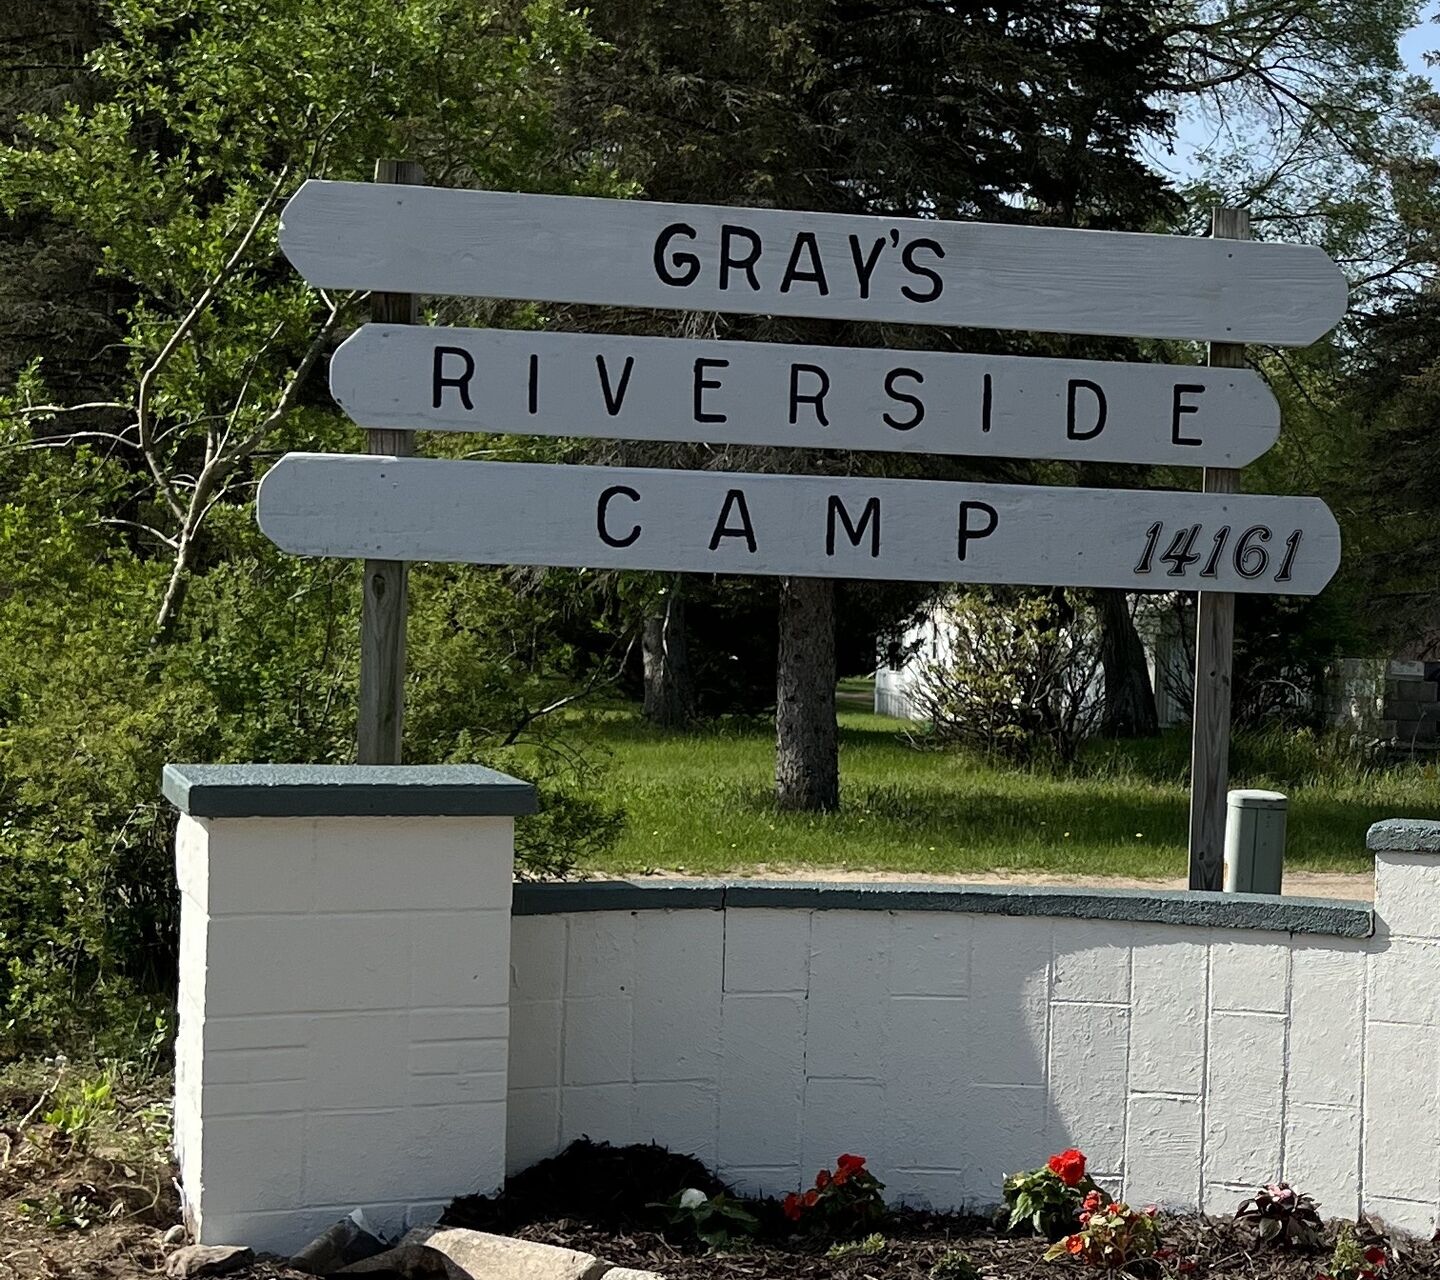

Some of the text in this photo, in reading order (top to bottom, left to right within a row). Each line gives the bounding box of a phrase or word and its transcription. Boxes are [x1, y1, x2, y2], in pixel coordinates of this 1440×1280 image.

[654, 222, 946, 303] GRAY'S
[431, 345, 1206, 447] RIVERSIDE
[596, 484, 999, 562] CAMP
[1134, 520, 1303, 583] 14161
